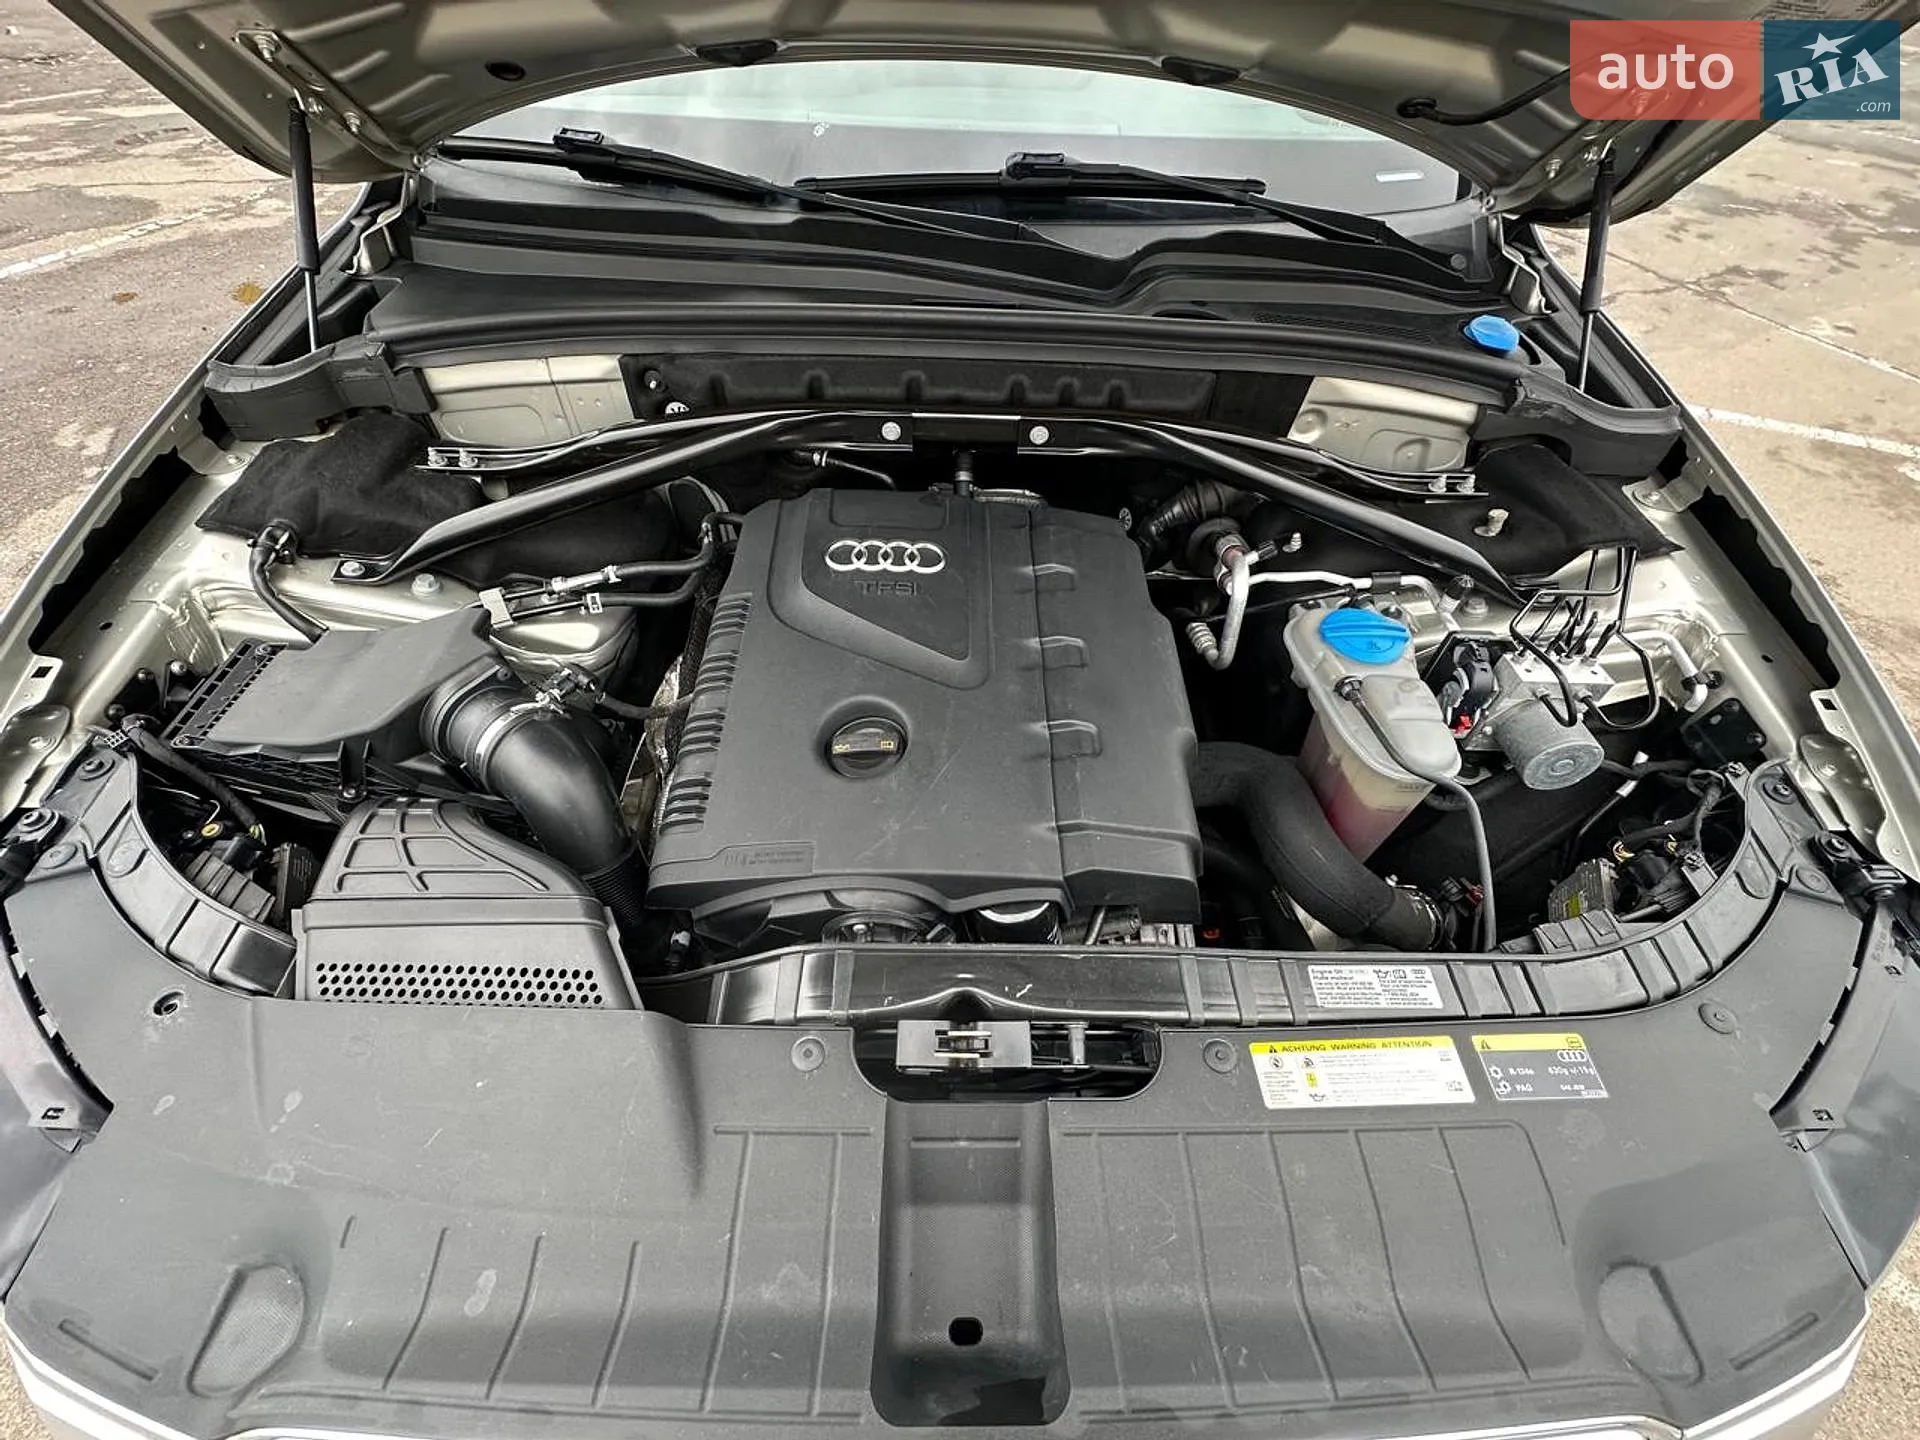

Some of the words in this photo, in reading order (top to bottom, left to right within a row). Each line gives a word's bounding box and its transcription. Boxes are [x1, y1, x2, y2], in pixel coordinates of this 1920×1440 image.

[853, 580, 917, 597] TFSI
[1281, 1043, 1327, 1053] ACHTUNG
[1330, 1041, 1377, 1052] WARNING
[1381, 1040, 1433, 1050] ATTENTION
